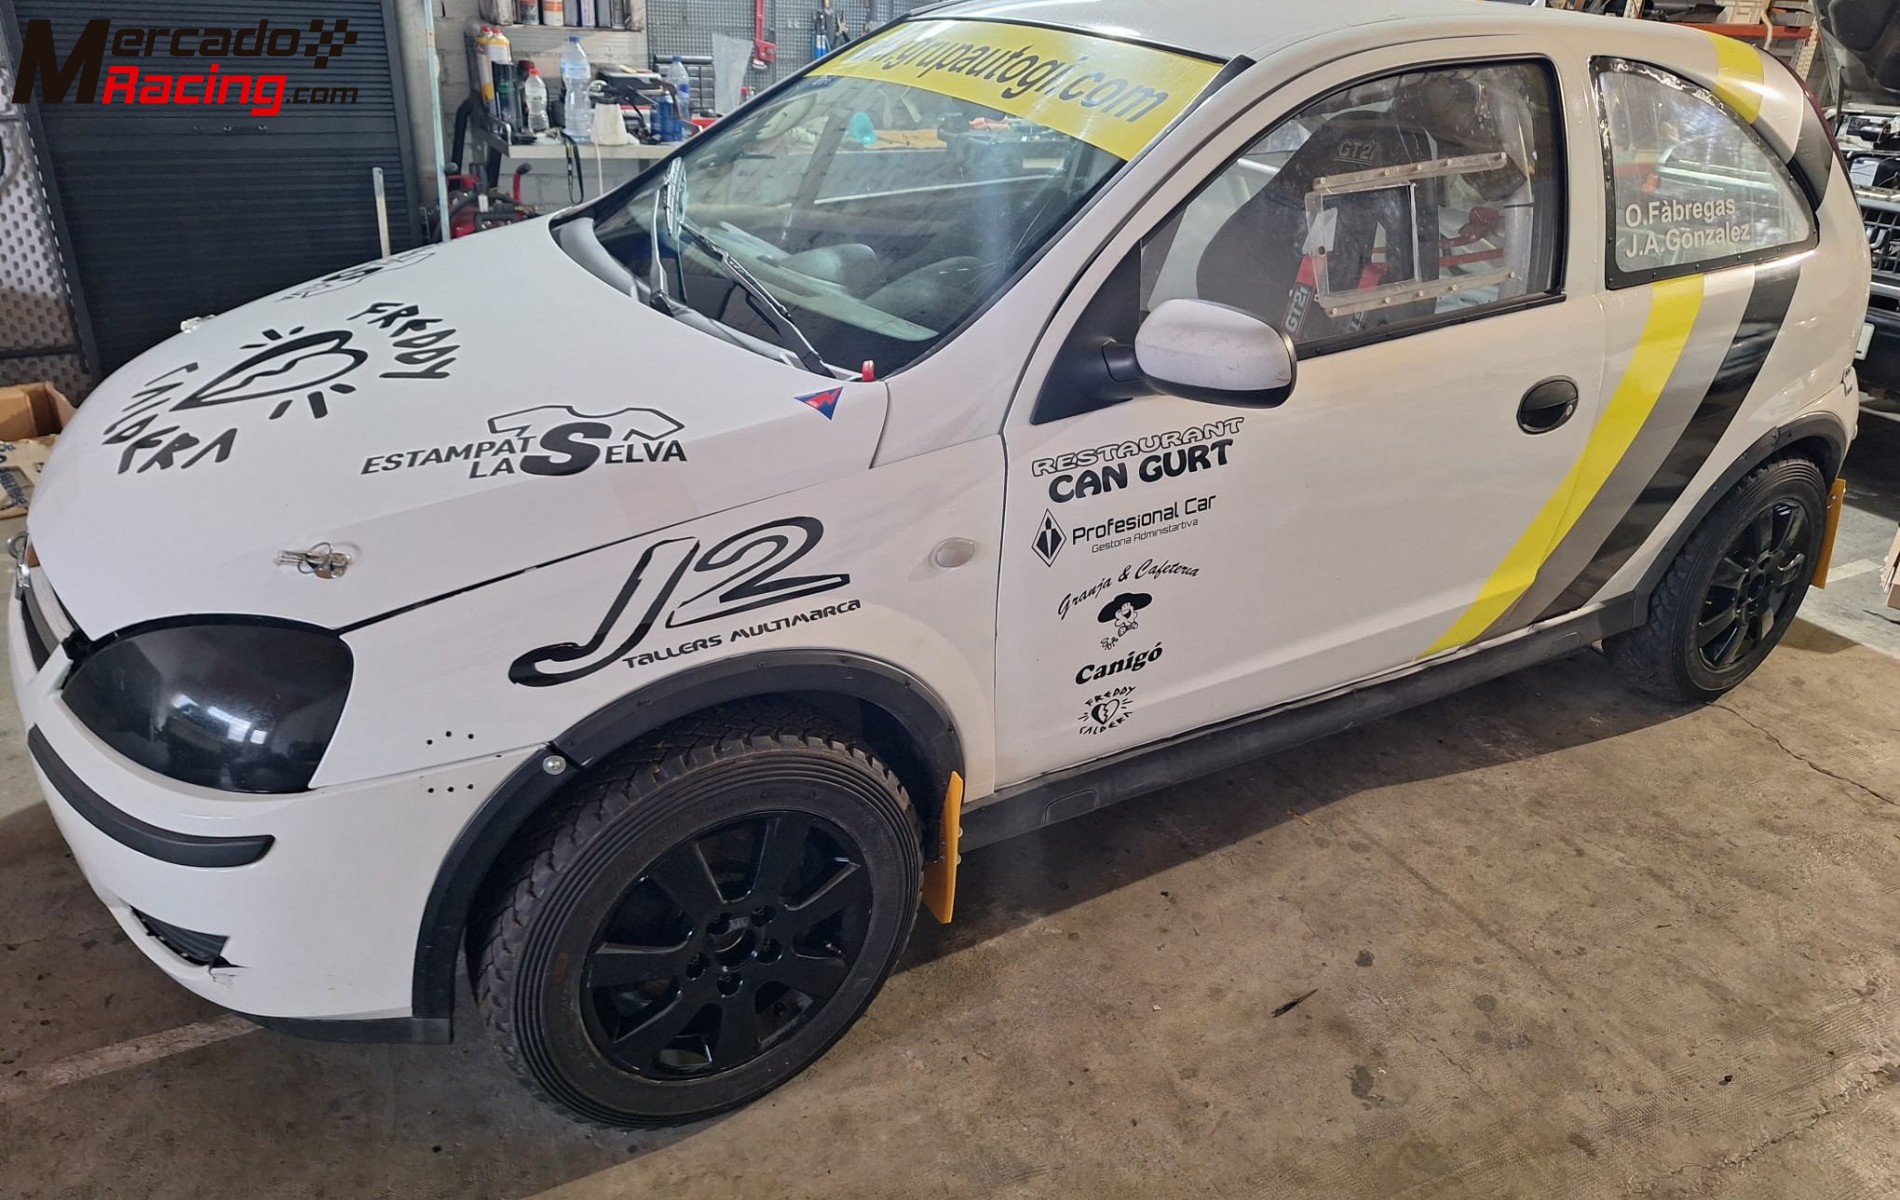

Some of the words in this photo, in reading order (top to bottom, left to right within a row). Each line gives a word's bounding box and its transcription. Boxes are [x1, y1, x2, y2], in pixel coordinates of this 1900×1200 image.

[853, 37, 1169, 123] w.grupautogi.com
[1625, 198, 1736, 228] O.Fàbregas
[1626, 221, 1751, 258] J.A.Gonzalez
[346, 302, 461, 379] FREDDY
[468, 456, 516, 479] LA
[1032, 417, 1245, 477] RESTAURANT
[1049, 462, 1128, 503] CAN
[1138, 438, 1234, 483] GURT
[1072, 502, 1179, 545] Profesional
[1184, 495, 1216, 515] Car
[508, 516, 850, 688] J2
[1057, 577, 1113, 621] Granja
[1117, 564, 1132, 583] &
[1134, 558, 1200, 580] Cafeteria
[1075, 641, 1163, 685] Canigó
[1085, 686, 1136, 706] FREDDY
